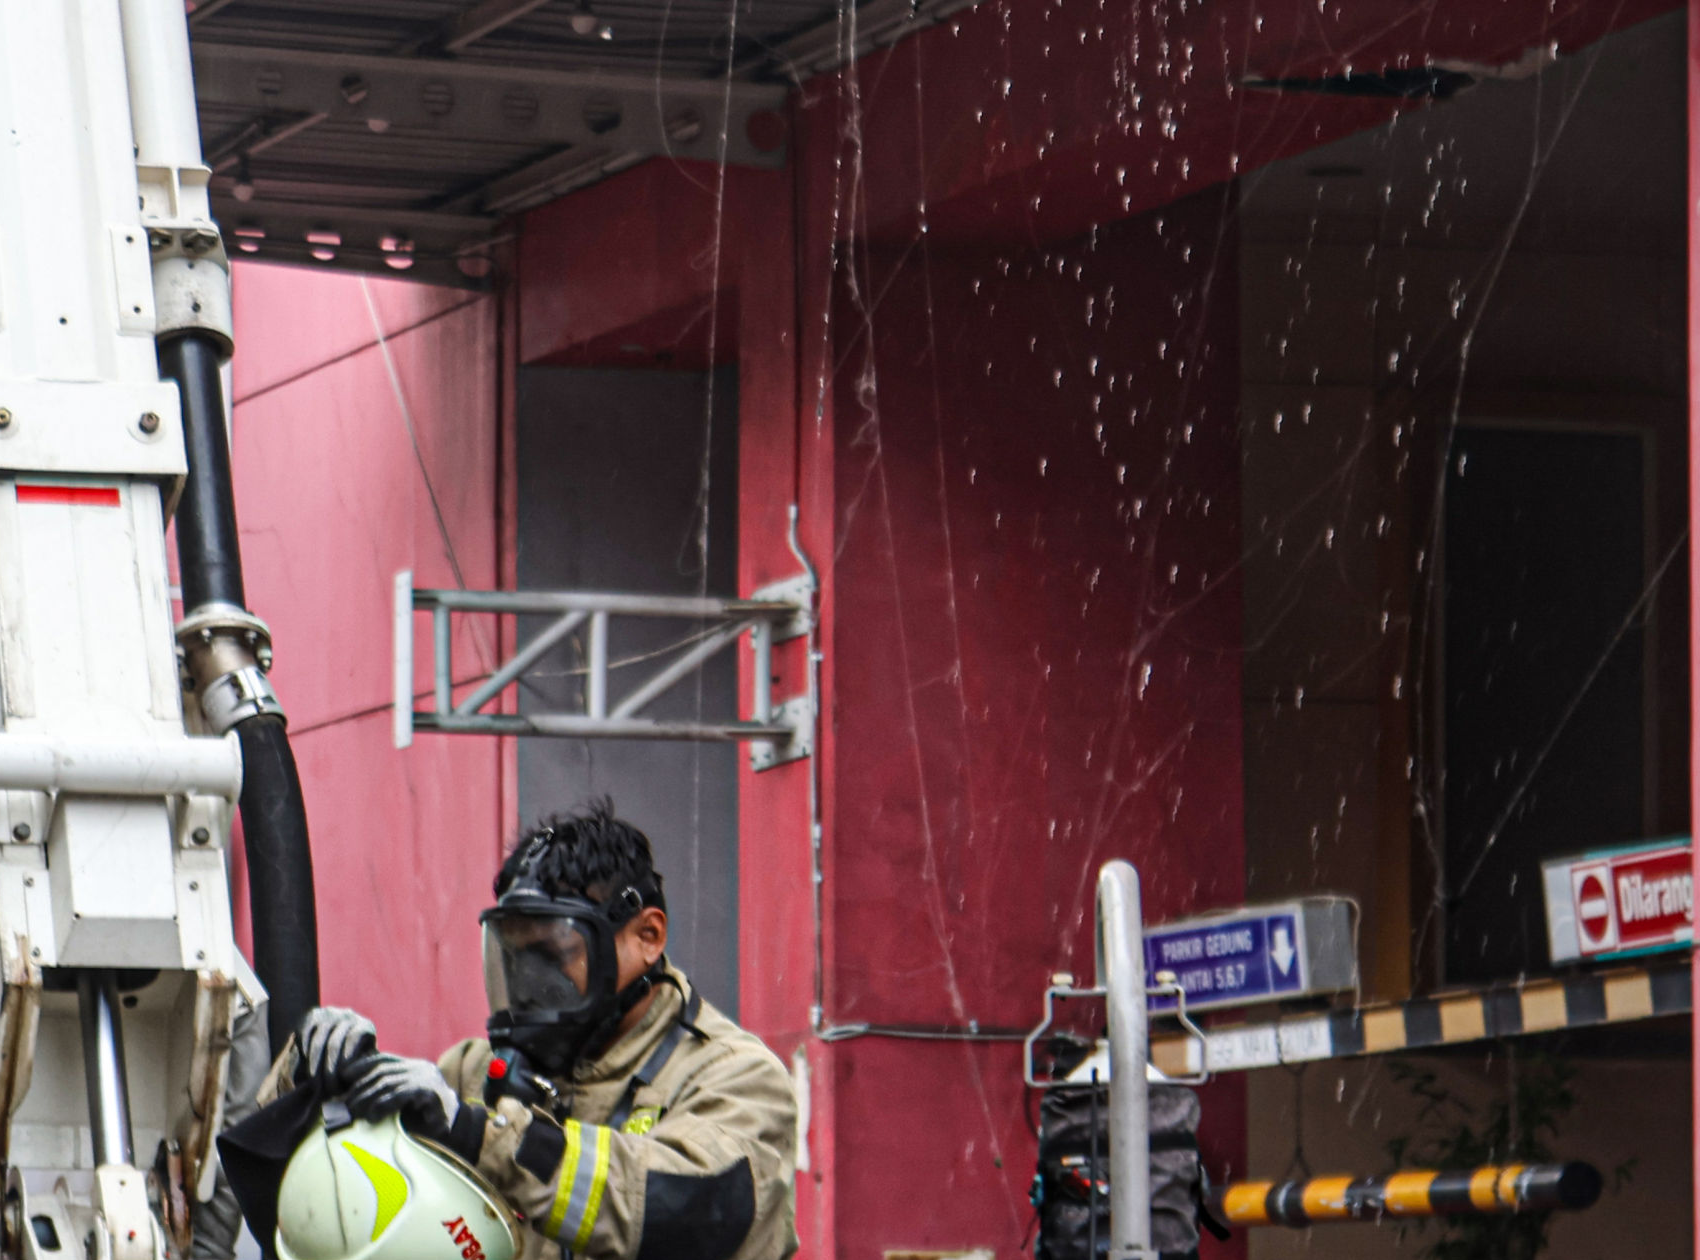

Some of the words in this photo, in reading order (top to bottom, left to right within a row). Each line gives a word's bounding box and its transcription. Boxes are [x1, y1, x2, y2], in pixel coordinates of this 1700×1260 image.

[1618, 872, 1693, 923] Dilarang
[1162, 938, 1203, 964] PARKIR
[1206, 929, 1253, 957] GEDUNG
[1180, 968, 1214, 993] ANTAI
